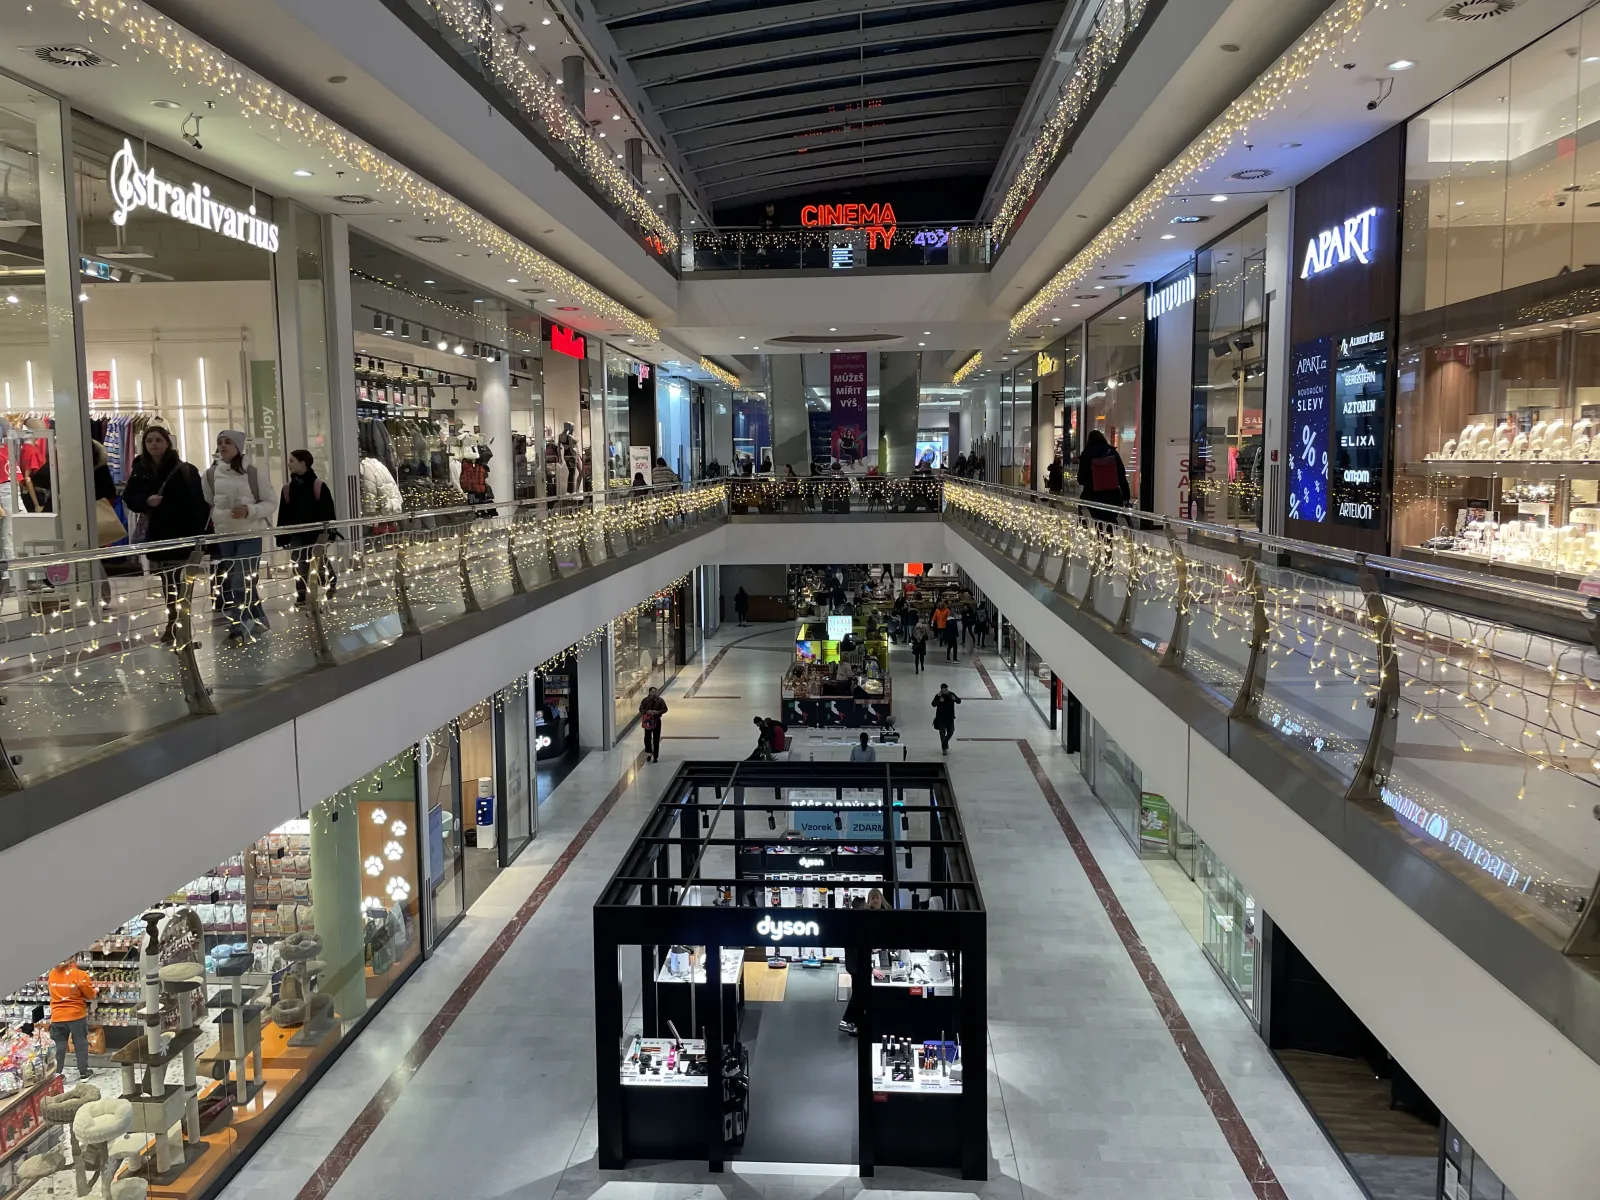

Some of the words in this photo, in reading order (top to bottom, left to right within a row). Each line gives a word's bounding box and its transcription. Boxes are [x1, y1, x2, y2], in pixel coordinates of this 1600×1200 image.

[801, 203, 896, 228] CINEMA
[1300, 207, 1376, 280] APART
[1296, 355, 1327, 374] APART.cz
[833, 372, 864, 383] MŮŽEŠ
[1344, 371, 1376, 387] BERGSTERN
[836, 385, 862, 395] MÍŘIT
[840, 397, 858, 408] VÝŠ
[1297, 397, 1324, 412] SLEVY
[1343, 399, 1377, 415] AZTORIN
[1341, 435, 1376, 447] ELIXA
[1178, 459, 1190, 519] SALE
[801, 822, 832, 831] Vzorek
[853, 823, 884, 832] ZDARM
[798, 856, 825, 868] dyson
[756, 915, 820, 941] dyson
